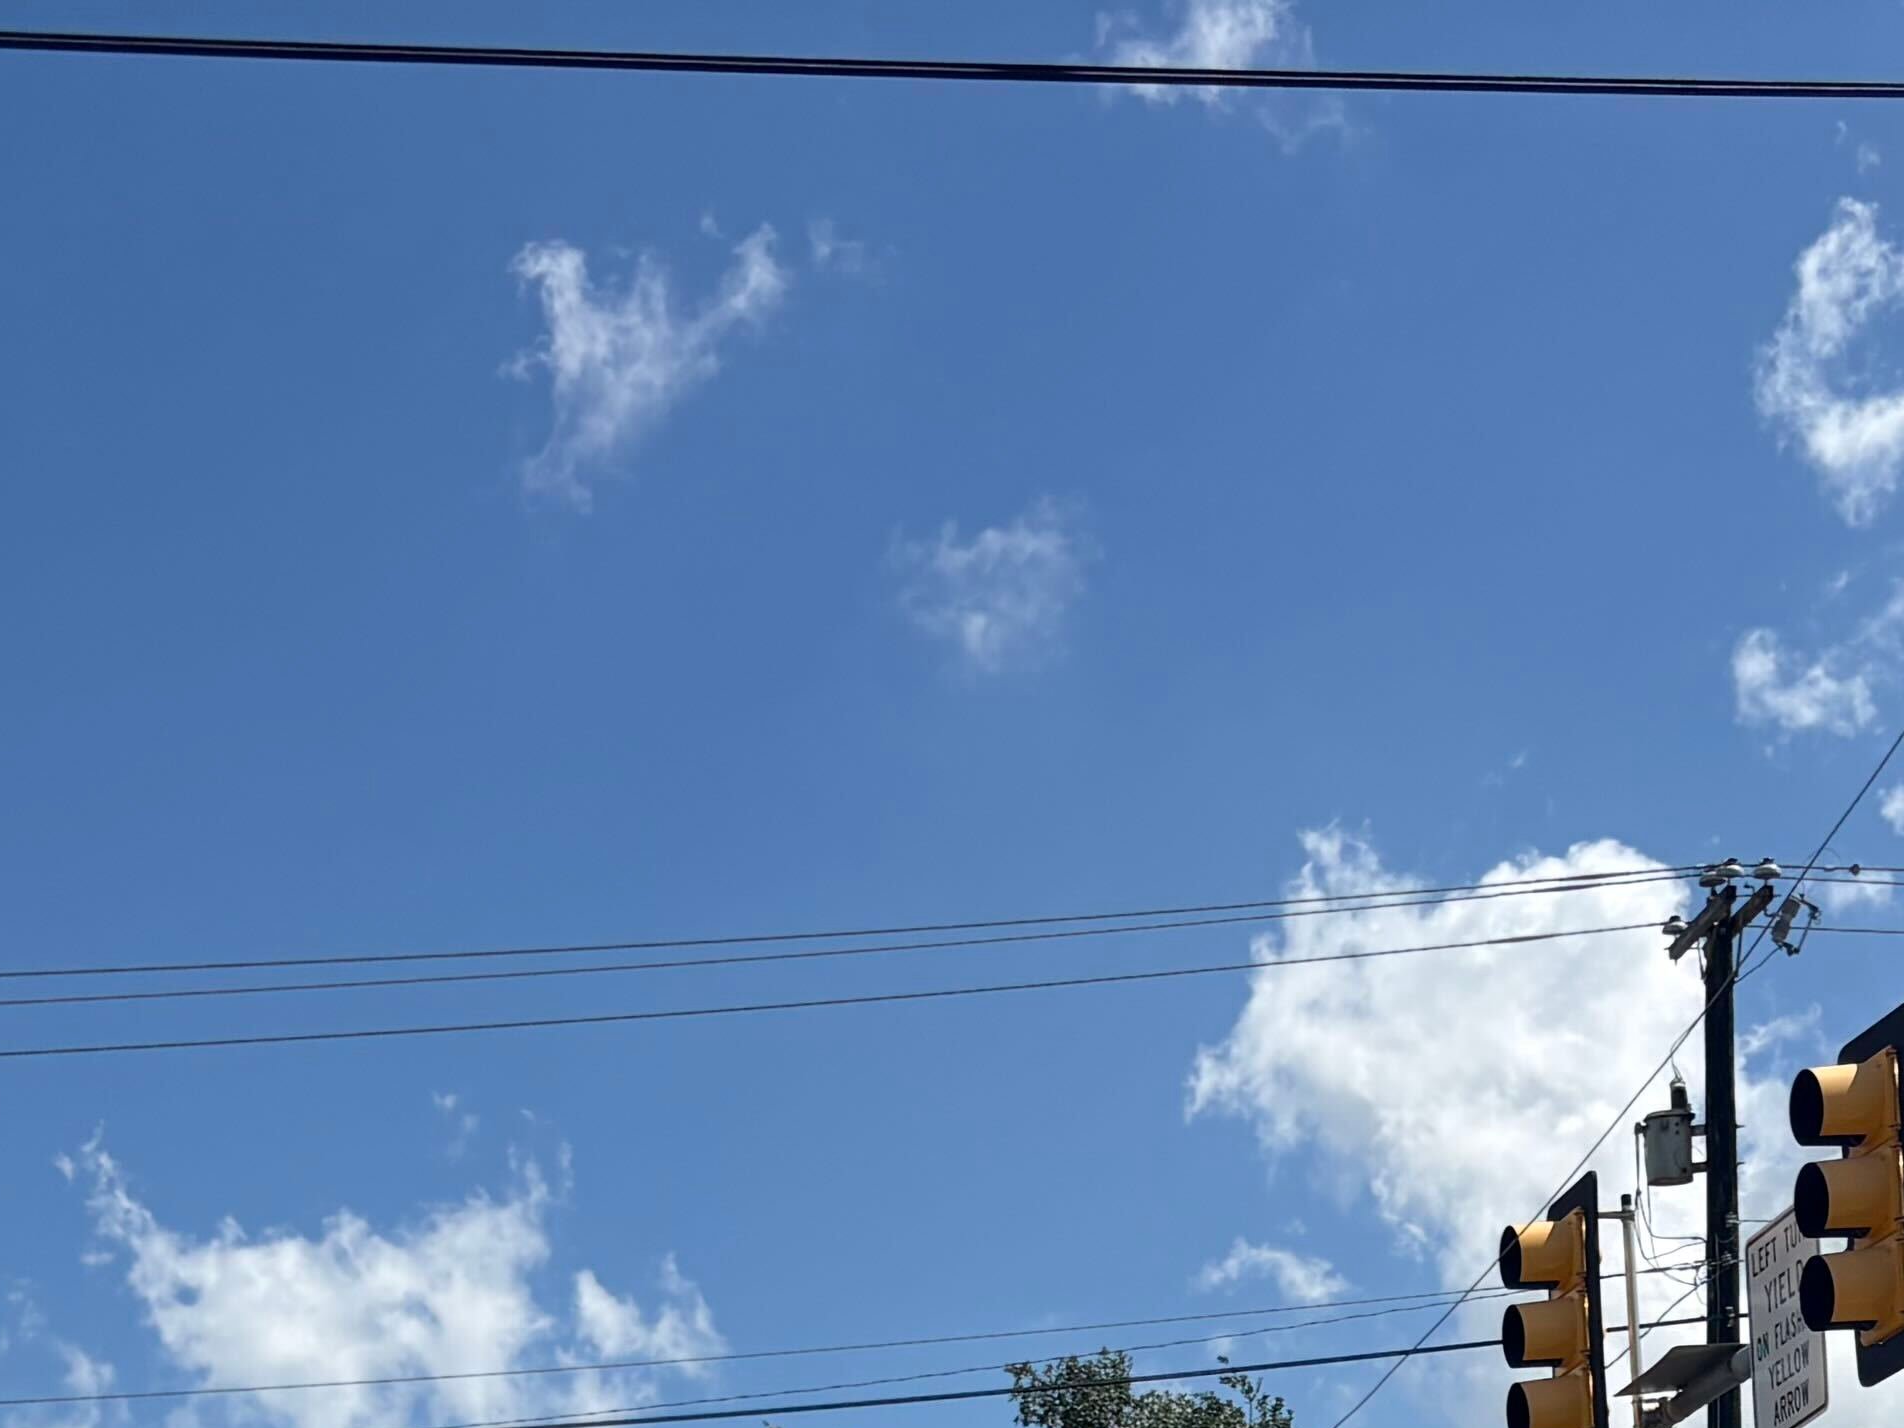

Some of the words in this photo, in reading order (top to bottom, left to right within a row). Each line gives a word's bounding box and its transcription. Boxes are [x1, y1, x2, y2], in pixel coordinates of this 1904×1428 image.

[1751, 1236, 1778, 1278] LEFT
[1756, 1331, 1770, 1362] ON
[1767, 1338, 1810, 1391] YELLOW
[1773, 1381, 1810, 1427] ARROW
